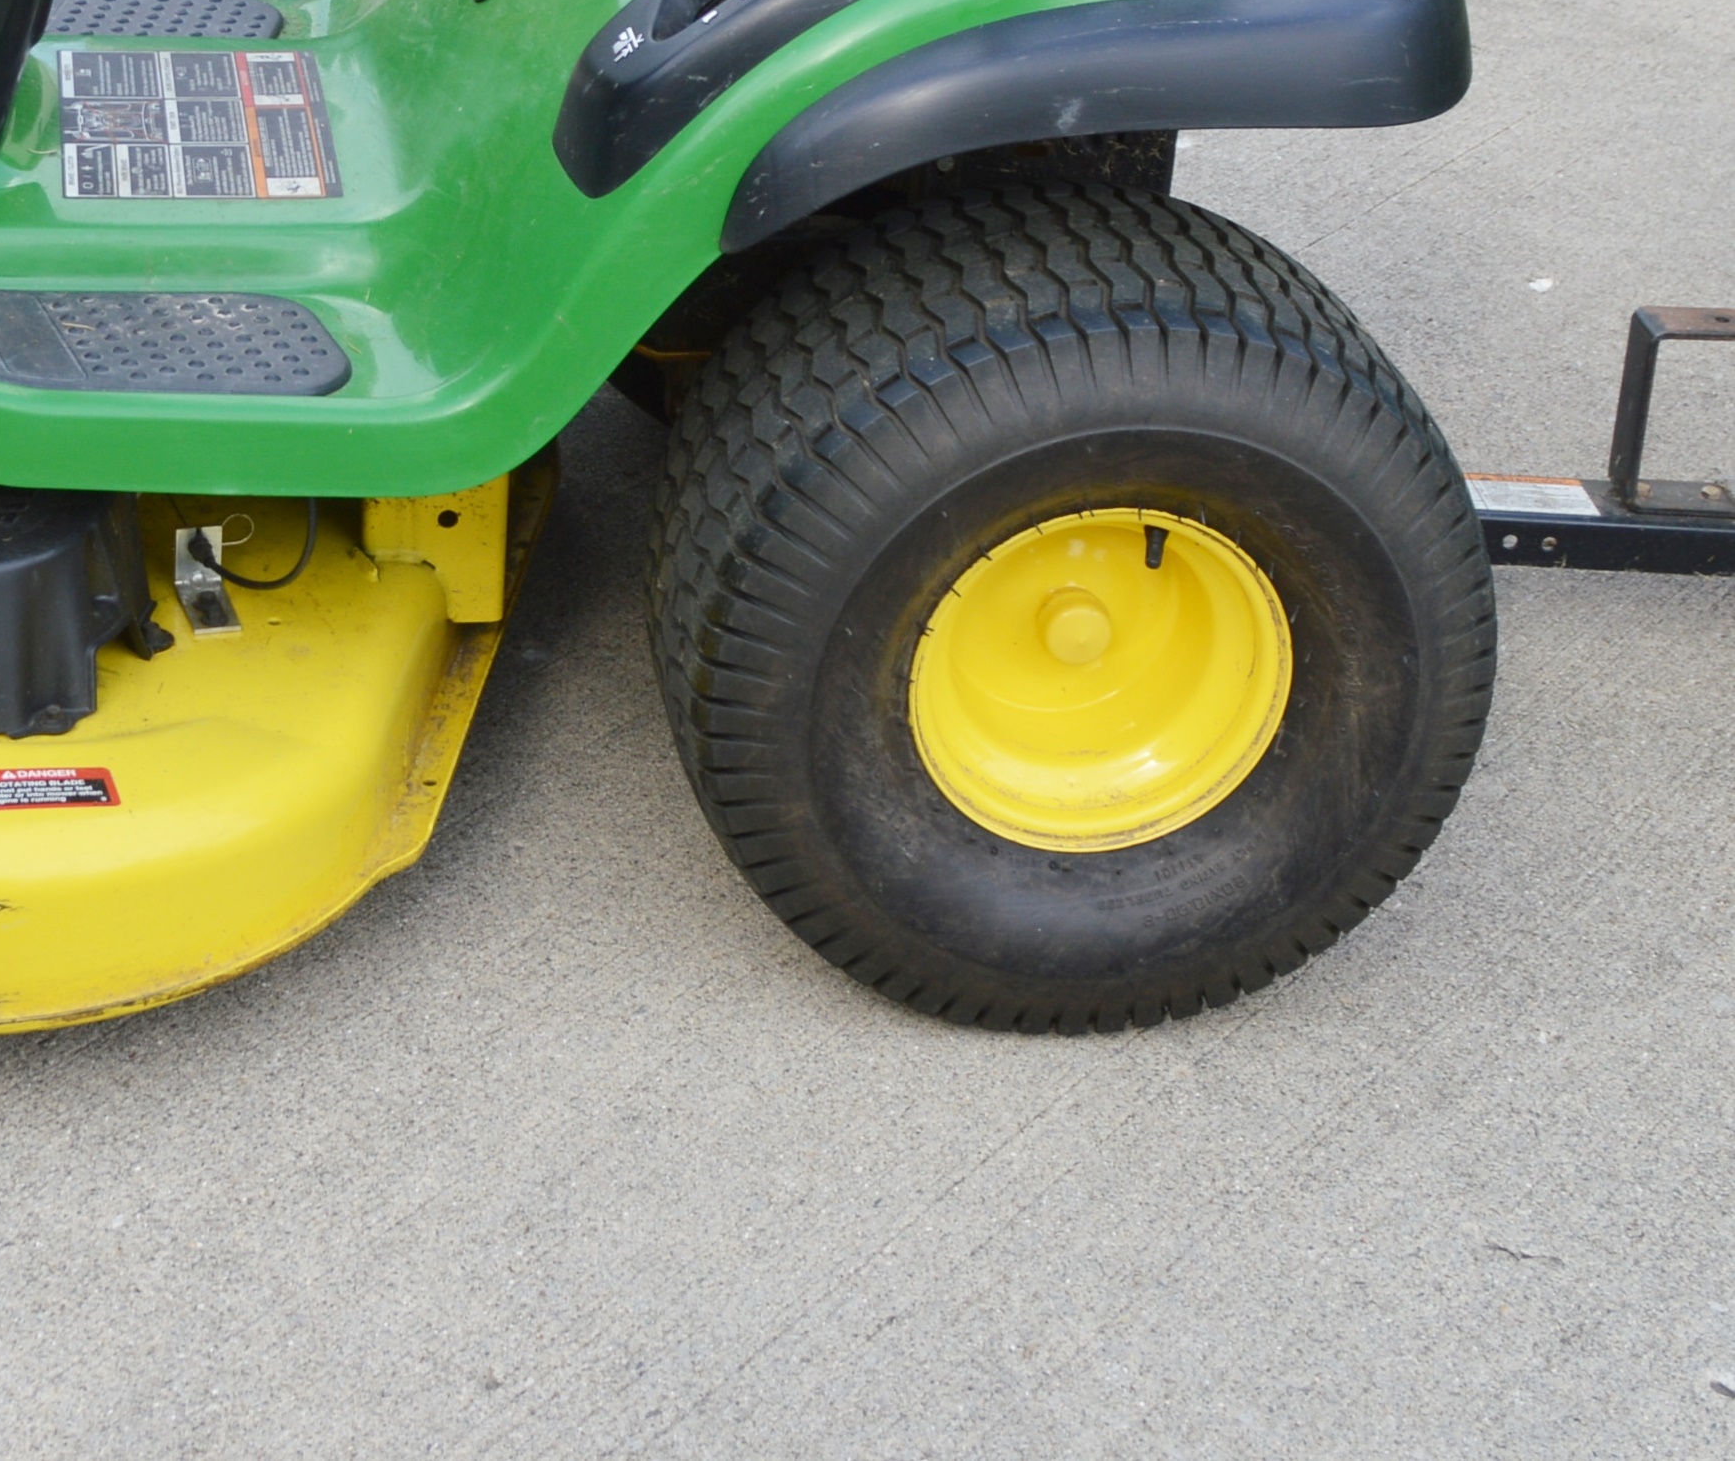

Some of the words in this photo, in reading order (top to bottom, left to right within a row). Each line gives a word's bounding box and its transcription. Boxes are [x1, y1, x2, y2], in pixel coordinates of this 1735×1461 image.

[16, 769, 77, 778] DANGER
[48, 779, 85, 787] BLADE
[16, 787, 32, 795] put
